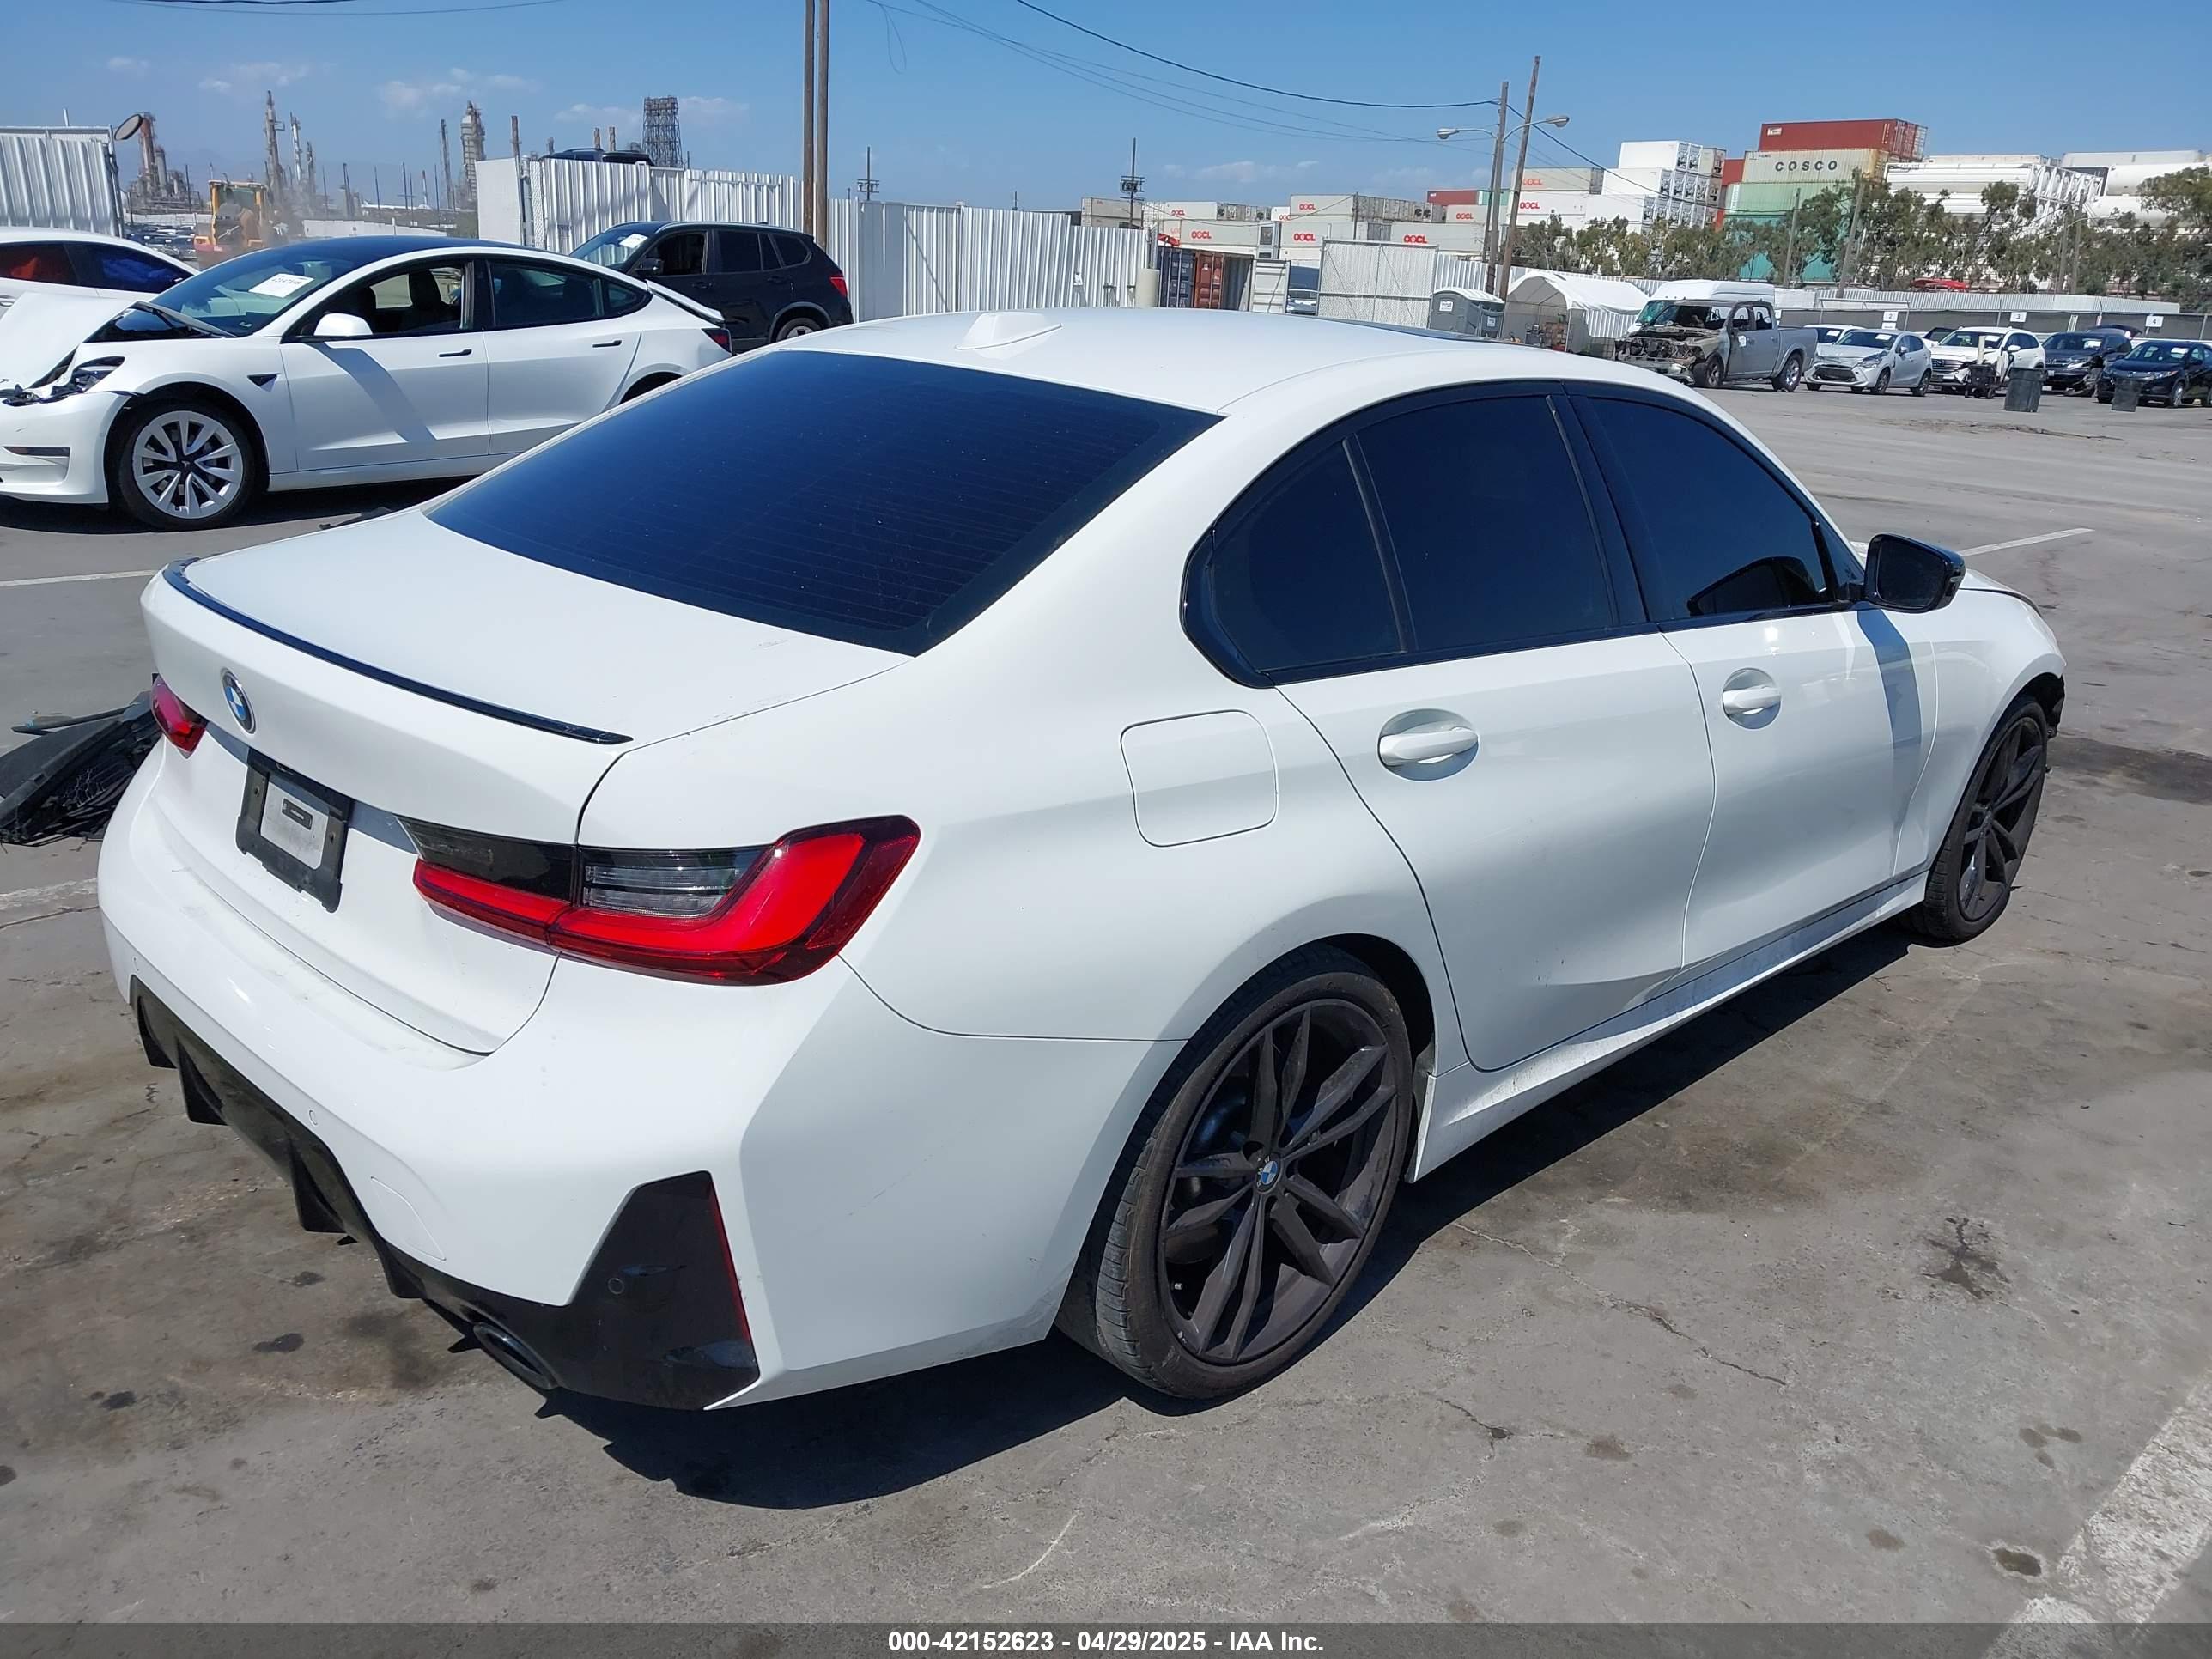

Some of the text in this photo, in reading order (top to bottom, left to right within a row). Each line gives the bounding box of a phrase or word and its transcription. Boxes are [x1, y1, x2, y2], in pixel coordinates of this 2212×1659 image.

[1775, 160, 1838, 172] COSCO
[1519, 201, 1540, 210] OOCL
[1190, 230, 1212, 240] OOCL
[1293, 233, 1316, 242] OOCL
[1403, 234, 1428, 244] OOCL
